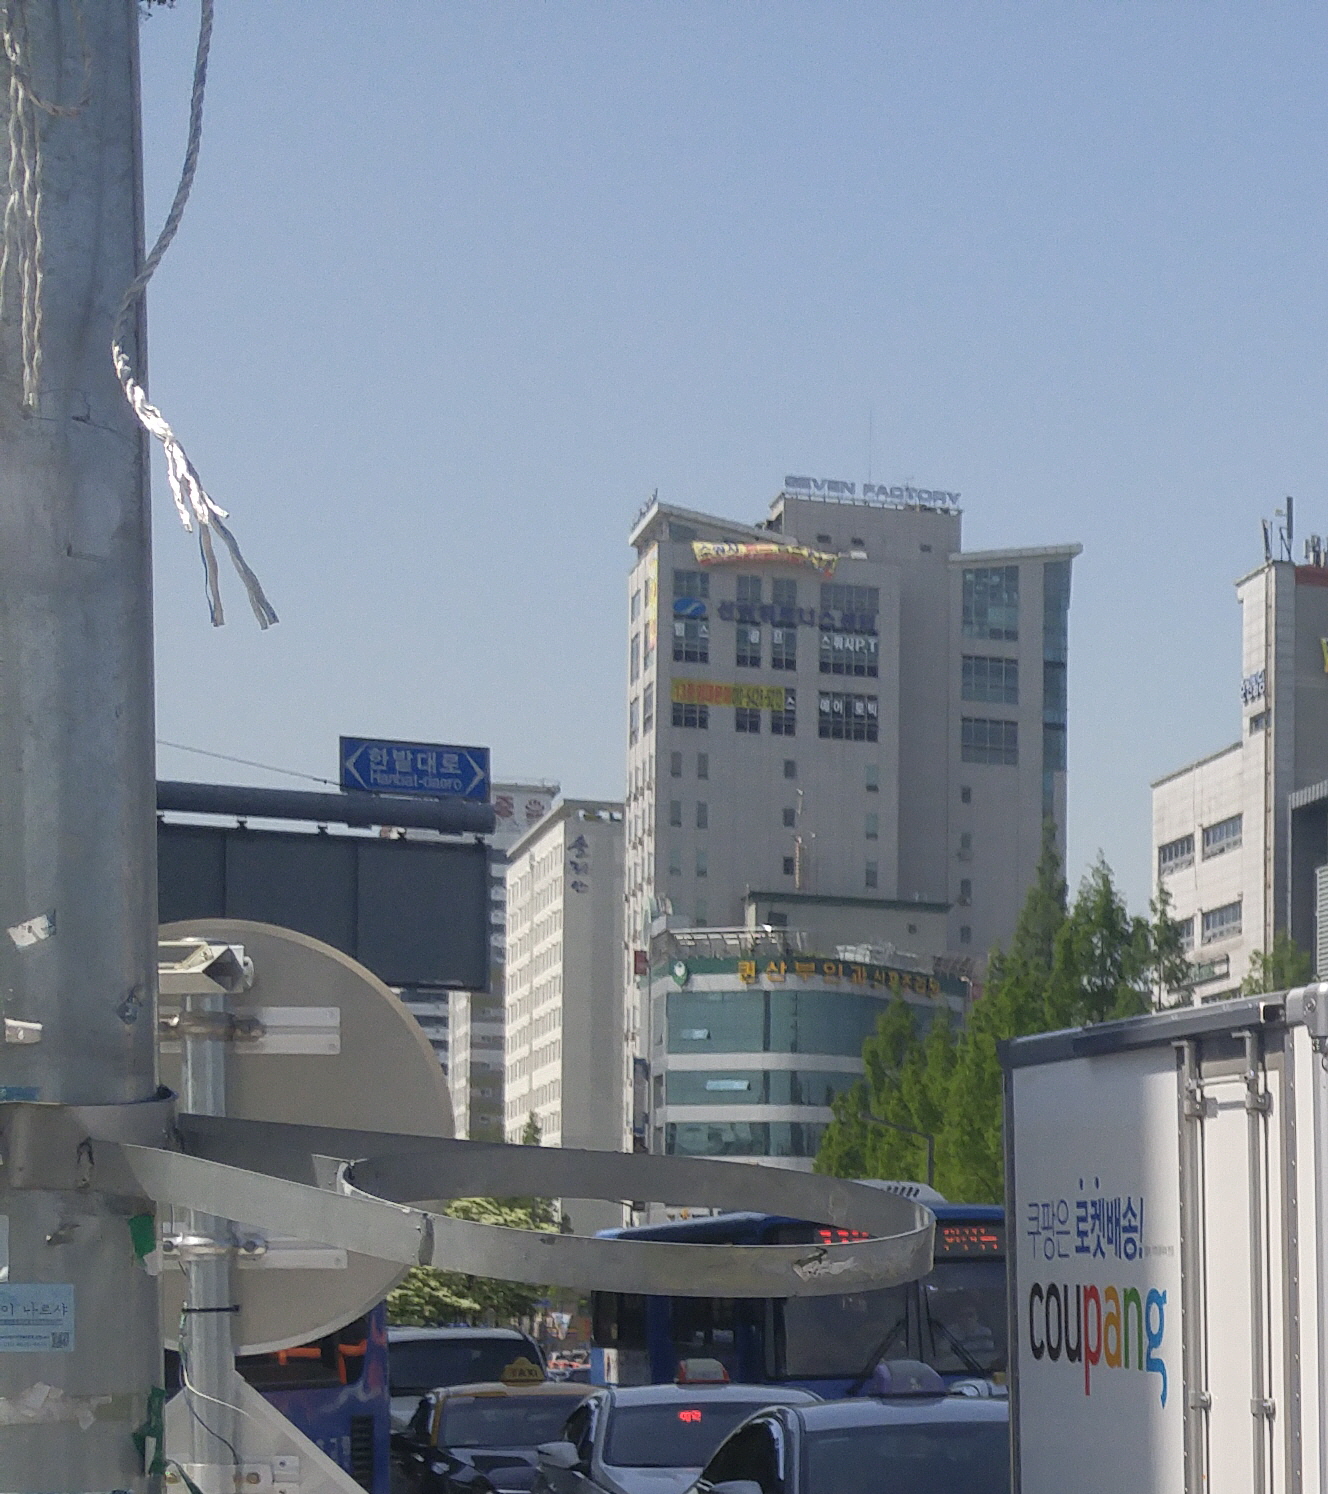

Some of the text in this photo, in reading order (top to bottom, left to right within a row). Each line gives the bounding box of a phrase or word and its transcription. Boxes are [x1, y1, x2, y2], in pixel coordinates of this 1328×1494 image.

[1026, 1177, 1144, 1262] 쿠팡은 로켓배송!
[1029, 1280, 1167, 1411] coupang
